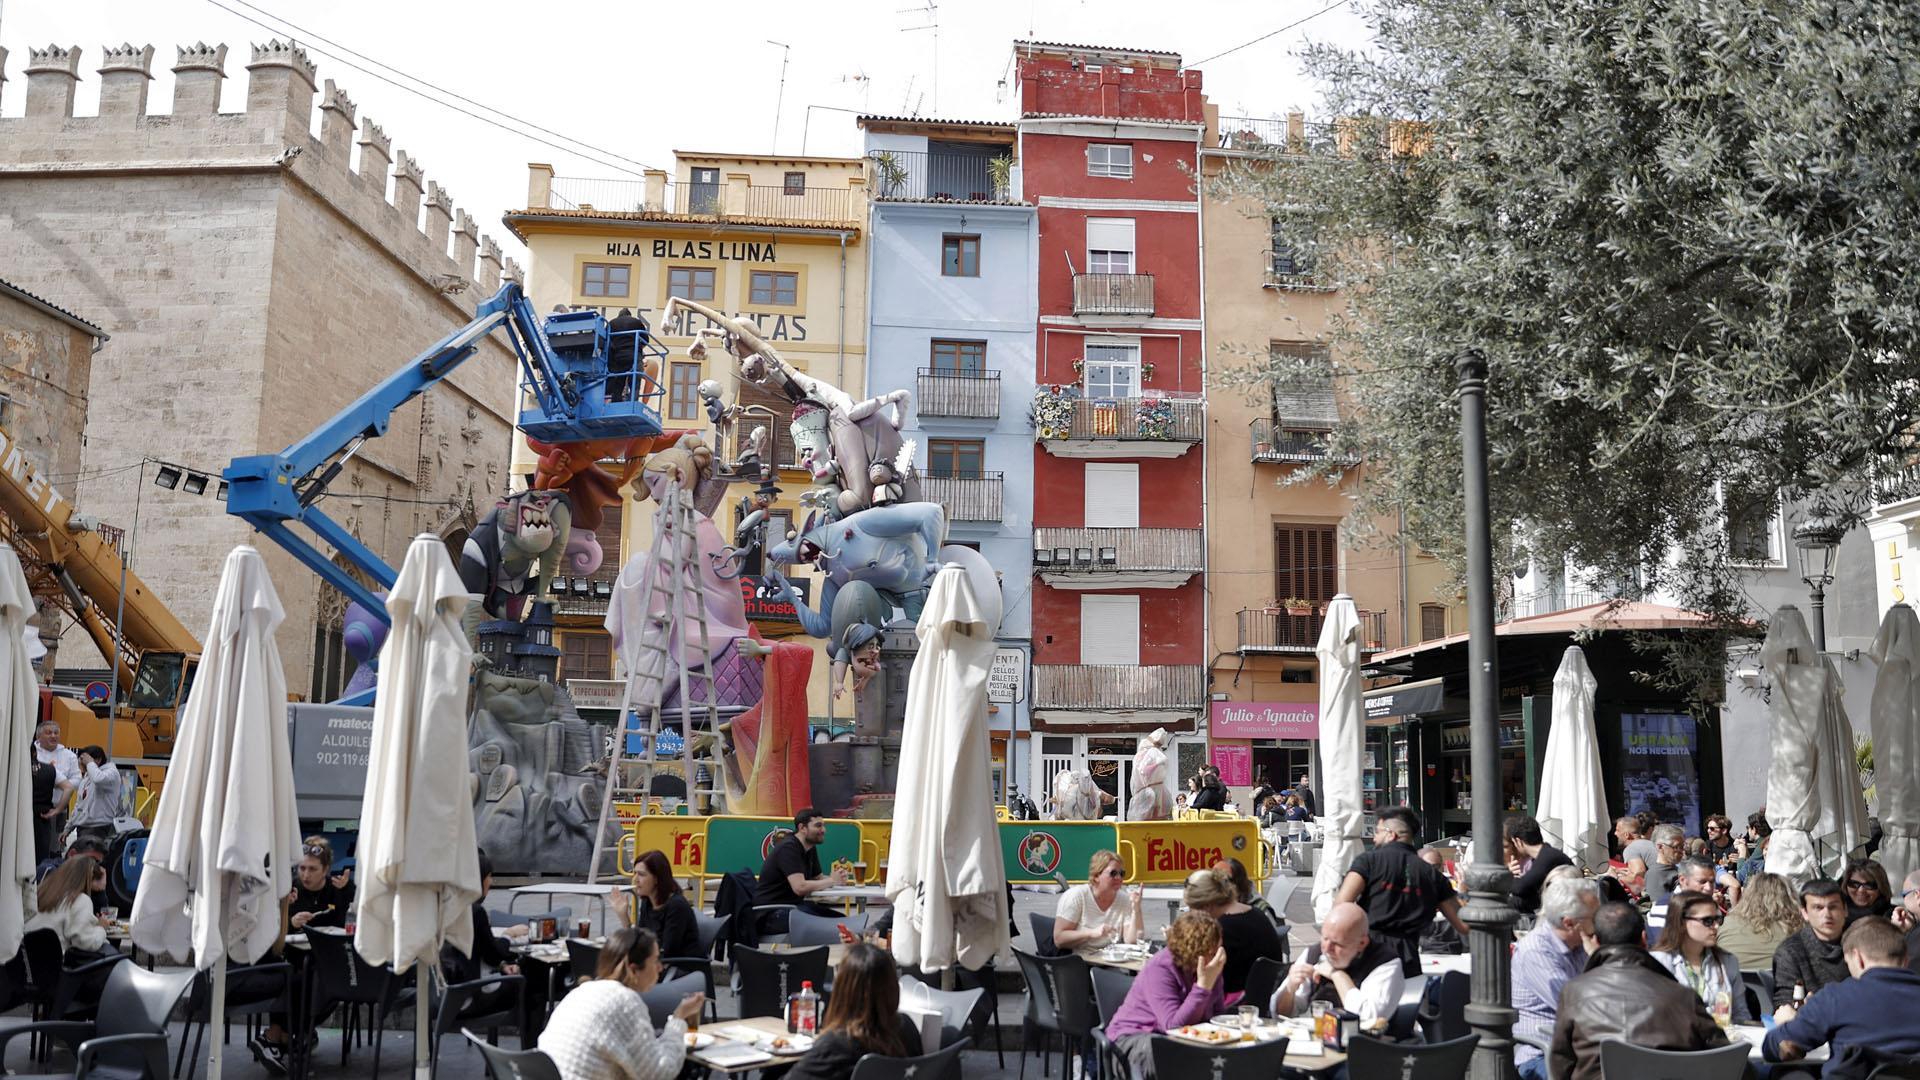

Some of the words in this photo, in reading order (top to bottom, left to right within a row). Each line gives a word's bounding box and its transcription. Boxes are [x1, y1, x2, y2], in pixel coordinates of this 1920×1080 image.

[607, 243, 641, 256] HIJA
[653, 239, 712, 259] BLAS
[719, 242, 776, 262] LUNA
[759, 600, 798, 614] hoste
[995, 656, 1019, 664] ENTA
[992, 674, 1019, 682] BILLETES
[574, 687, 616, 697] ESPECIALIDAD
[1220, 707, 1254, 725] Julio
[1263, 708, 1315, 726] Ignacio
[328, 718, 374, 730] mateco
[1629, 746, 1649, 755] NOS
[1649, 746, 1690, 755] NECESITA
[317, 752, 340, 765] 902
[1147, 837, 1224, 872] Fallera
[347, 951, 358, 987] Heineken
[779, 972, 787, 1009] Heineken
[1048, 974, 1061, 1010] Heineken
